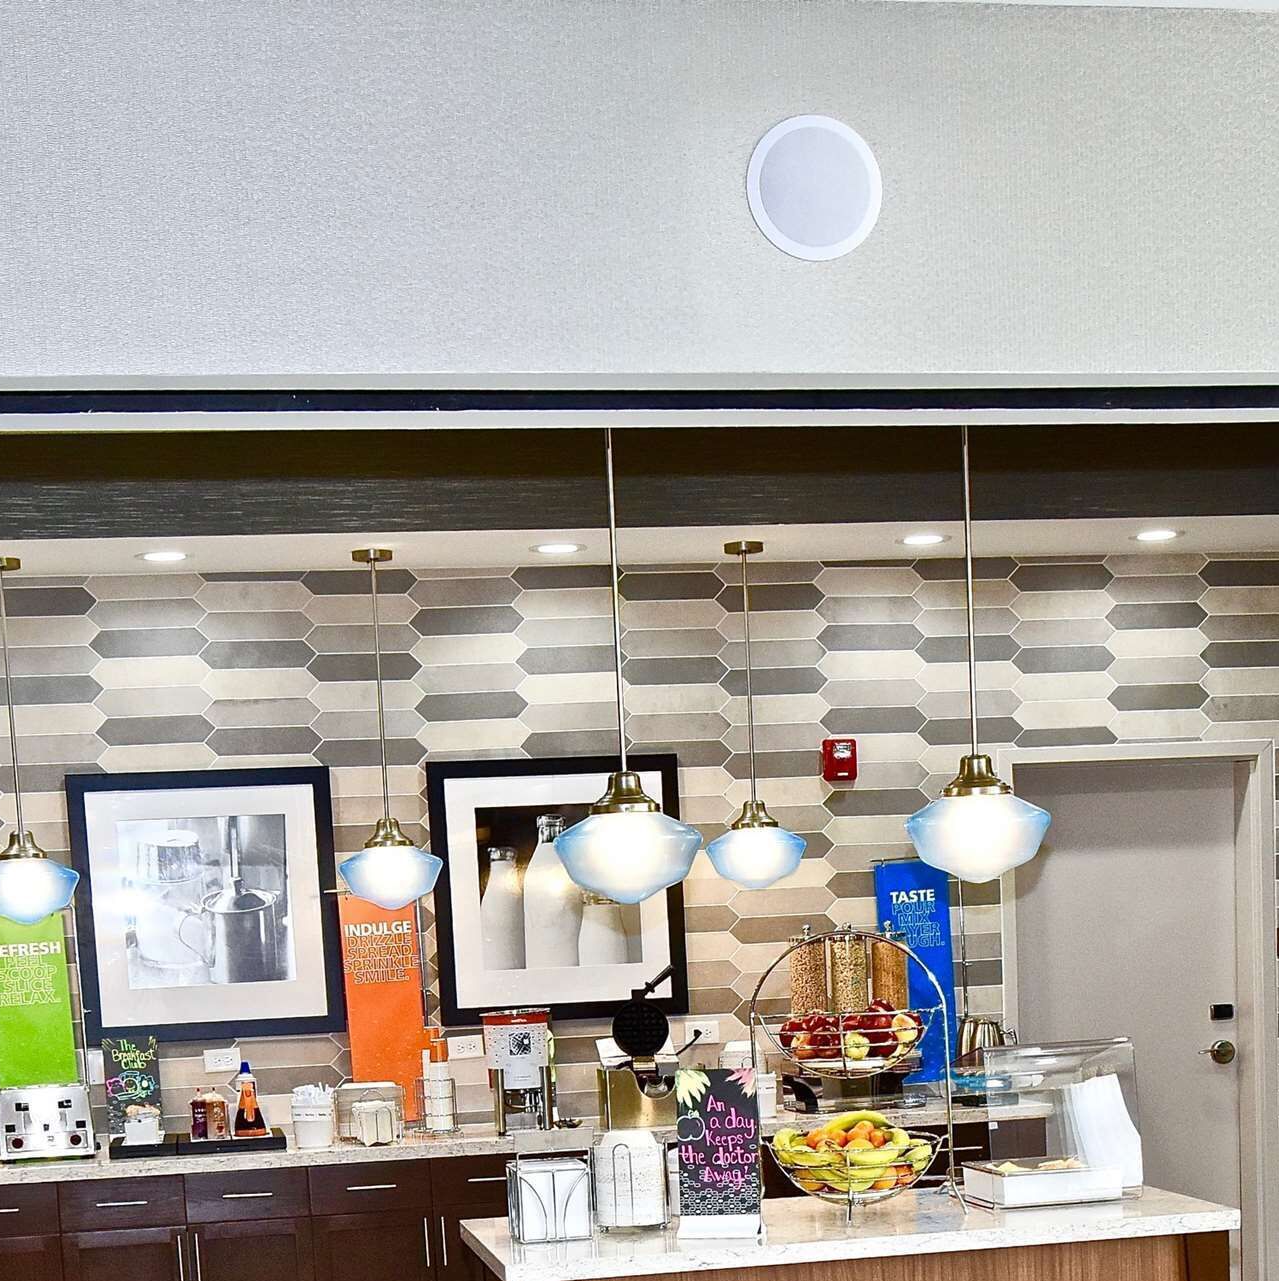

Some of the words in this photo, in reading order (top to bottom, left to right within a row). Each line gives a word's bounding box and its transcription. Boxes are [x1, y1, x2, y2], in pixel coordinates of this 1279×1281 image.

[889, 888, 936, 904] TASTE
[891, 900, 936, 916] POUR
[897, 912, 931, 927] MIX
[344, 920, 412, 937] INDULGE
[892, 921, 941, 937] AYER
[345, 932, 413, 949] DRIZZLE
[346, 943, 414, 961] SPREAD
[3, 954, 48, 970] PEEL
[343, 954, 420, 974] SPRINKLE
[354, 967, 411, 985] SMILE.
[2, 977, 56, 994] SLICE
[117, 1038, 137, 1051] The
[111, 1048, 157, 1062] Breakfast
[120, 1058, 147, 1070] Club
[706, 1094, 726, 1112] An
[709, 1116, 721, 1129] a
[678, 1145, 707, 1165] the
[711, 1146, 760, 1165] doctor
[704, 1165, 749, 1190] Away!
